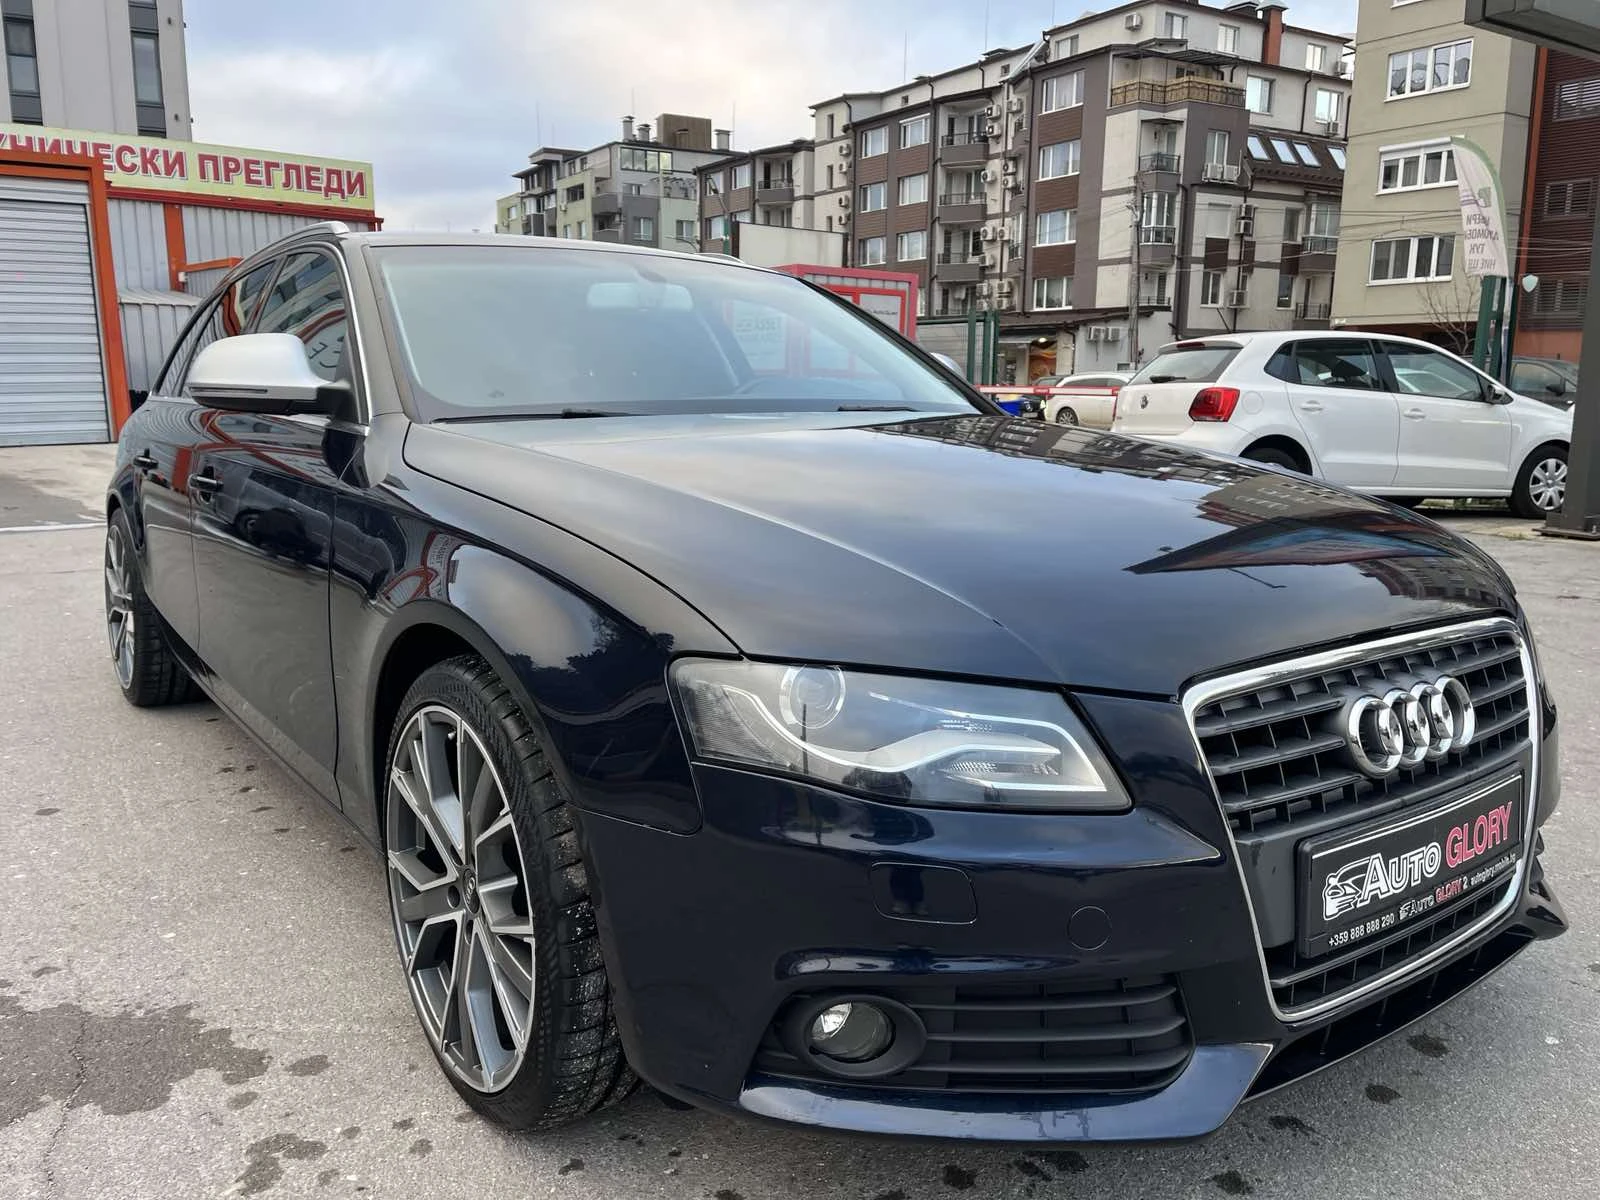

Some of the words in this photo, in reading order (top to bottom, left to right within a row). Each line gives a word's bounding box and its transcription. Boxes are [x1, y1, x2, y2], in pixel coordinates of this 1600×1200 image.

[0, 132, 188, 179] НИЧЕСКИ
[197, 153, 367, 200] ПРЕГЛЕДИ
[1356, 842, 1442, 907] AUTO
[1445, 800, 1513, 869] GLORY
[1408, 894, 1435, 917] AUTO
[1435, 878, 1463, 903] GLORY
[1462, 876, 1469, 890] 2
[1328, 930, 1349, 946] +359
[1350, 924, 1365, 940] 888
[1366, 918, 1380, 934] 888
[1381, 913, 1395, 928] 290
